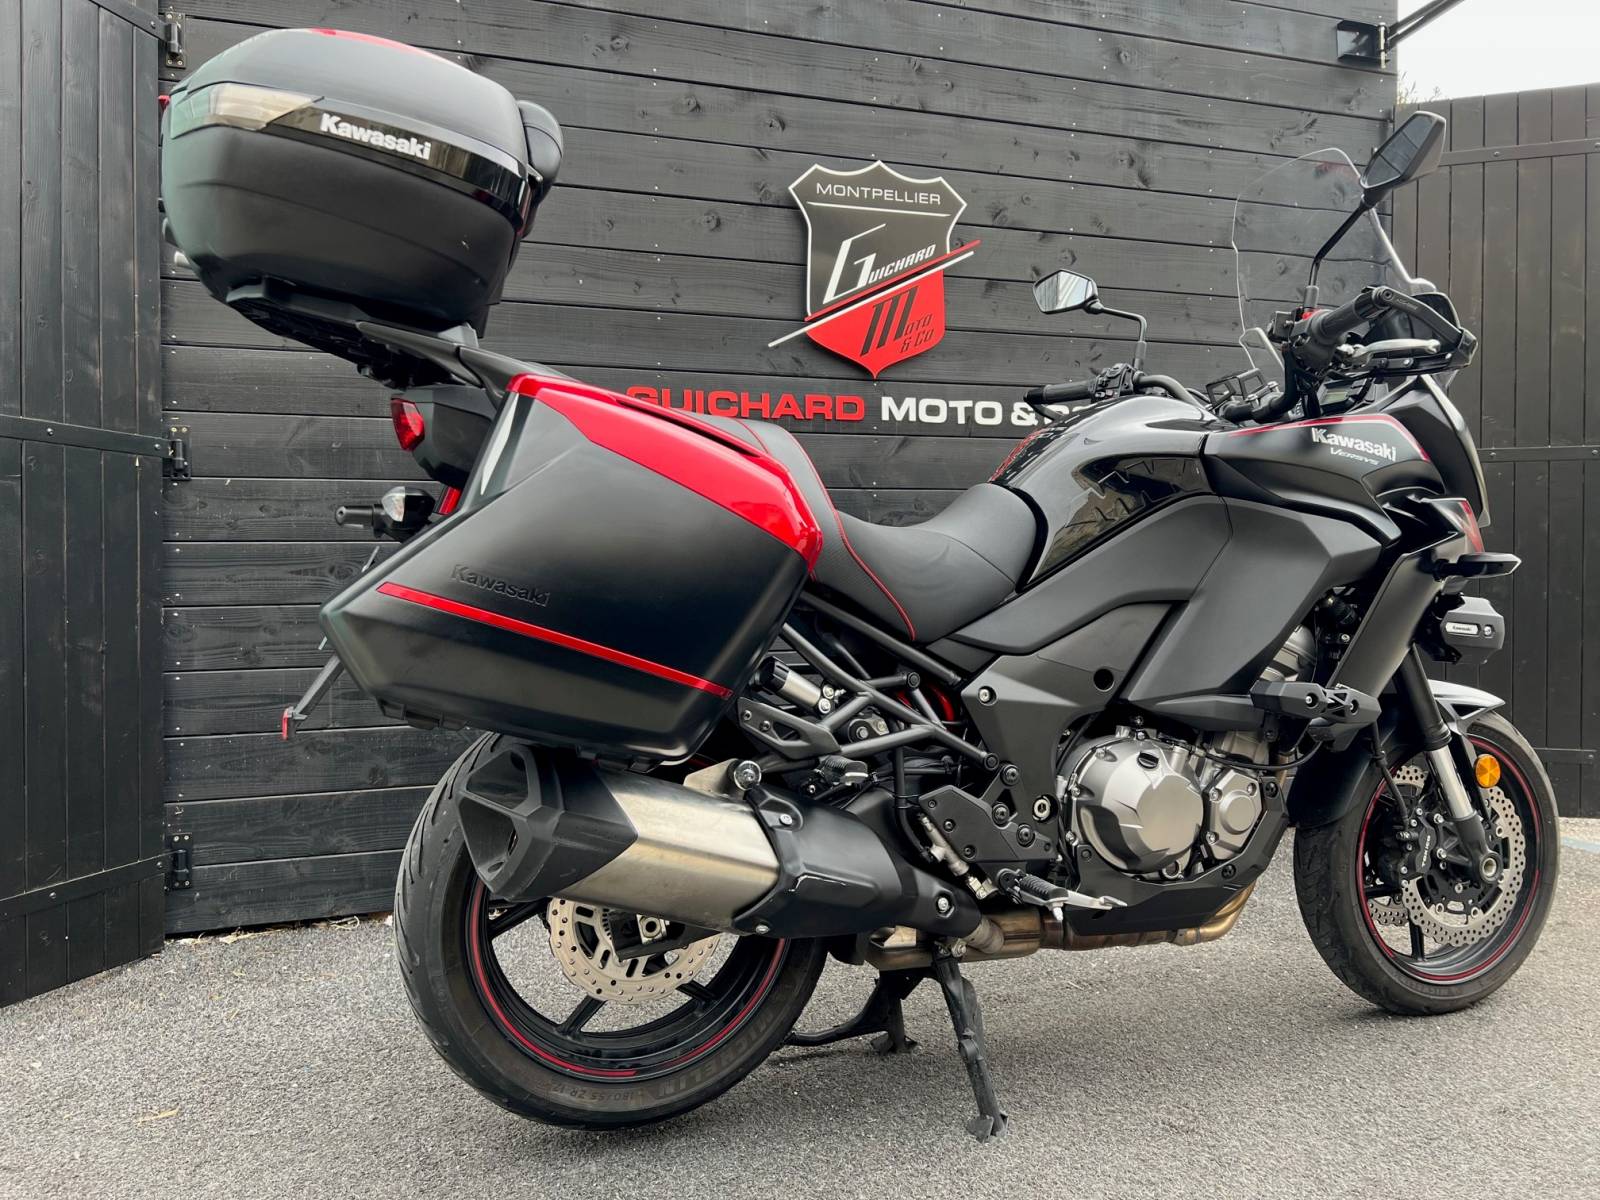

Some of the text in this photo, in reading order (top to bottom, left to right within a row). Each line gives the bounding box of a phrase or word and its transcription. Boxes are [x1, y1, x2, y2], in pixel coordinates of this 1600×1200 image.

[320, 112, 431, 160] Kawasaki
[816, 182, 942, 205] MONTPELLIER
[881, 396, 1003, 425] MOTO
[1010, 402, 1038, 426] &
[1311, 427, 1397, 462] Kawasaki
[449, 563, 551, 608] Kawasaki
